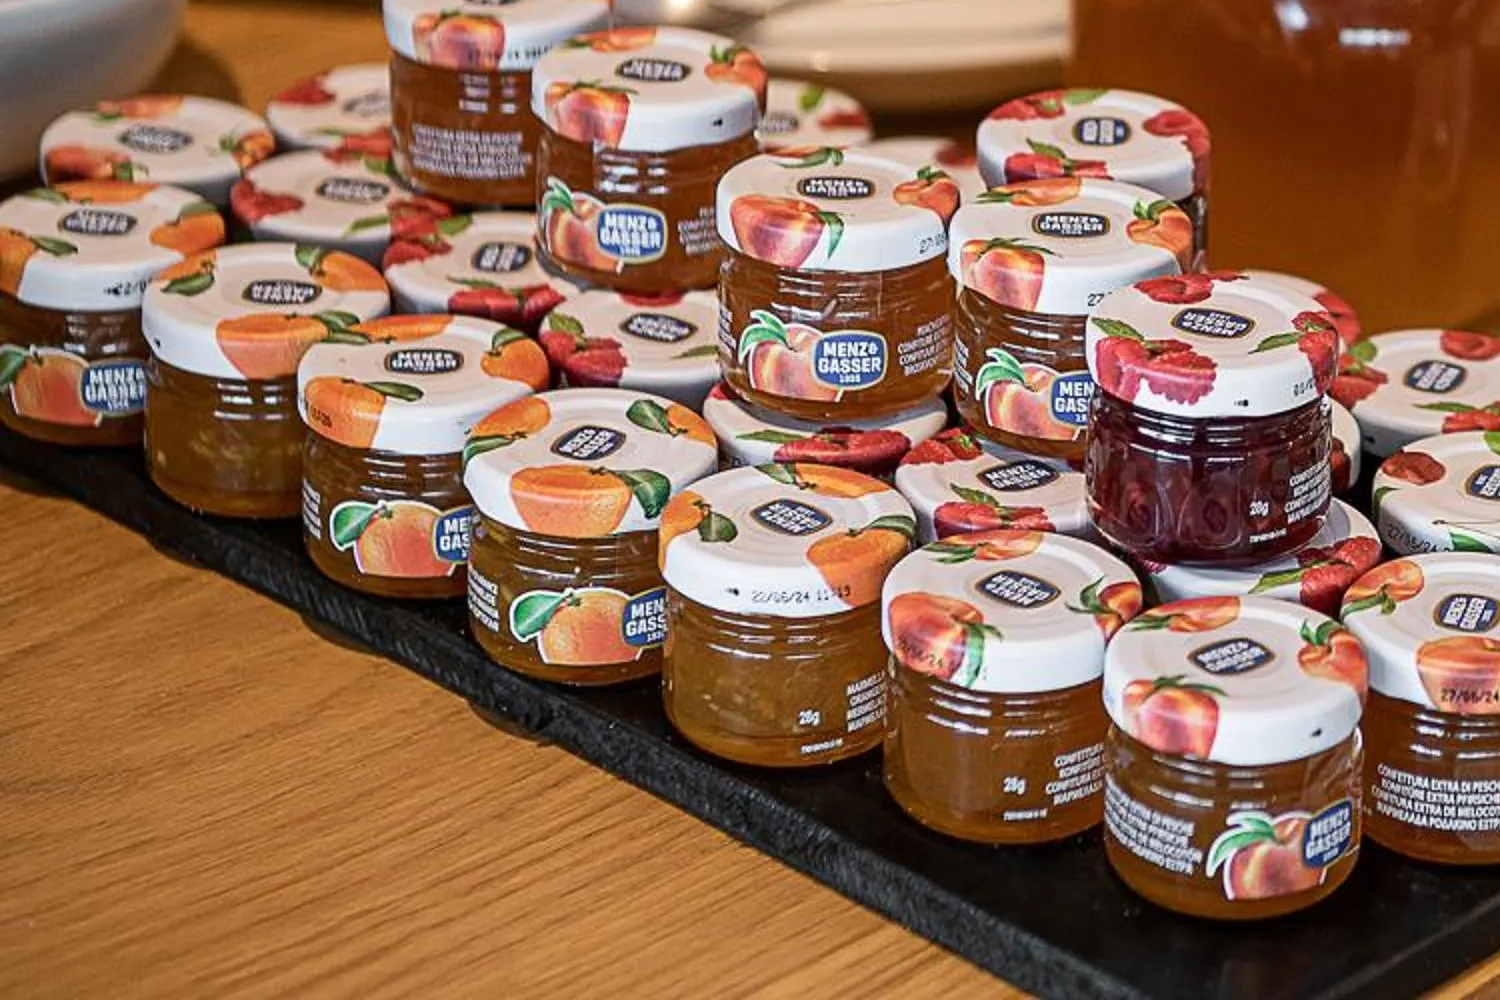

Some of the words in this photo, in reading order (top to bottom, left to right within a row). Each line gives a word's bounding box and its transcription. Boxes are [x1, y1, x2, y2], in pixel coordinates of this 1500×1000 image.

[818, 356, 882, 374] GASSER
[1059, 381, 1095, 397] MEN
[1055, 397, 1090, 413] GAS
[631, 597, 665, 619] MEN
[626, 613, 668, 637] GASS
[1432, 779, 1459, 793] EXTRA
